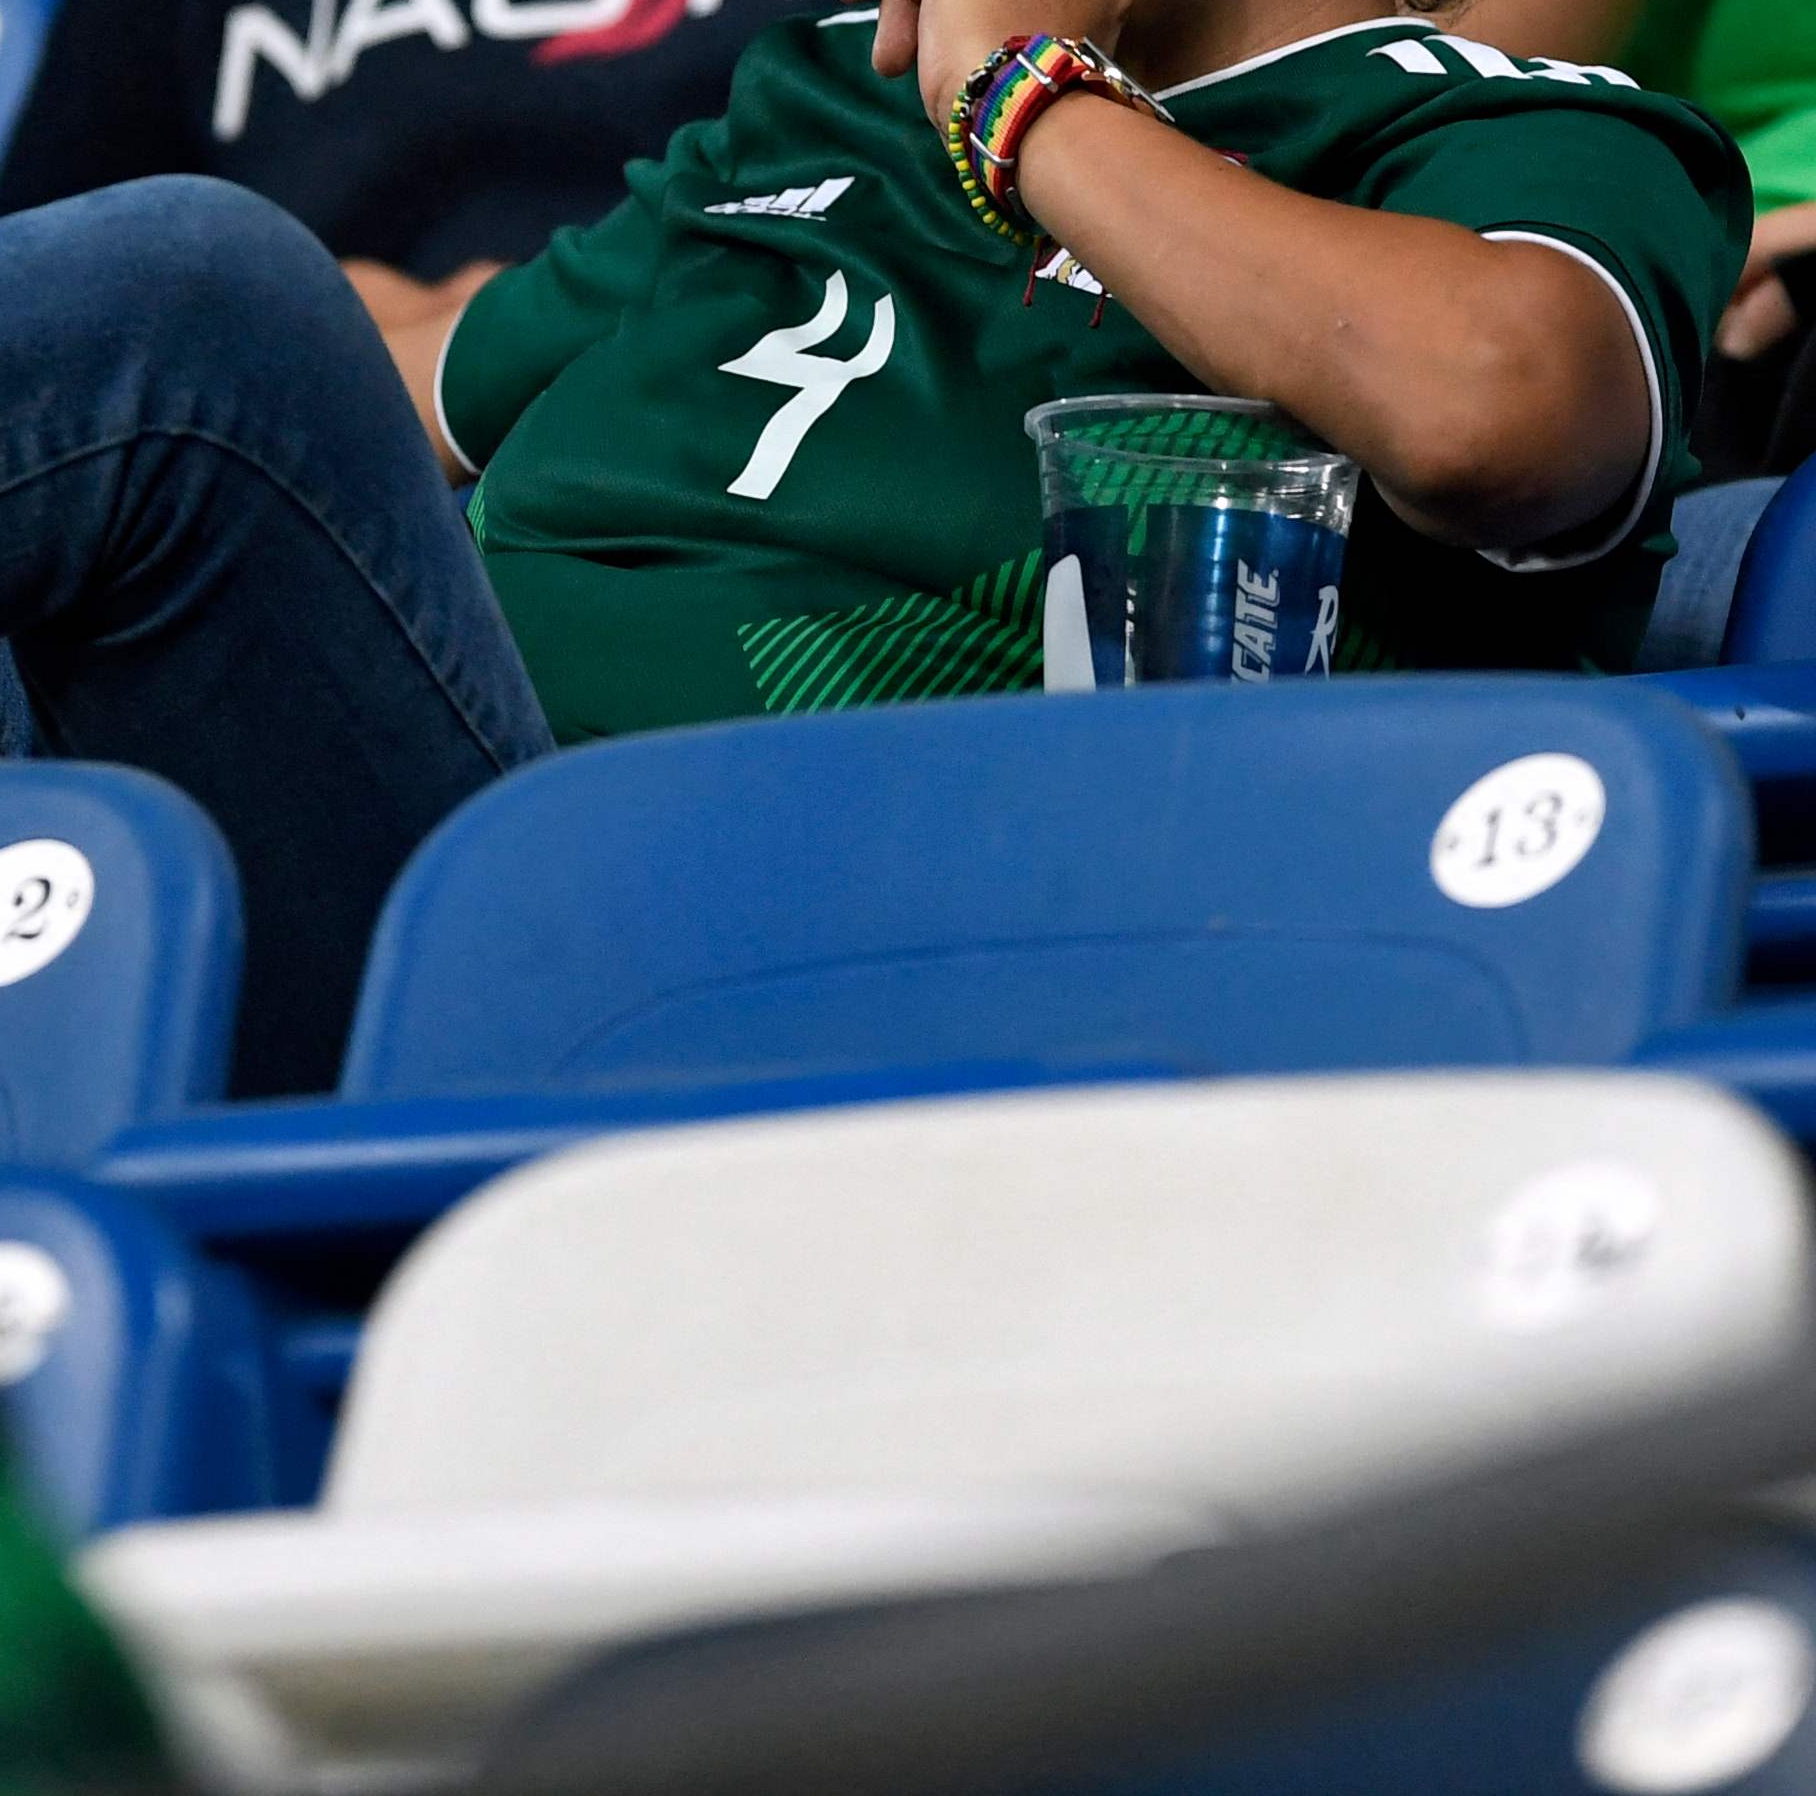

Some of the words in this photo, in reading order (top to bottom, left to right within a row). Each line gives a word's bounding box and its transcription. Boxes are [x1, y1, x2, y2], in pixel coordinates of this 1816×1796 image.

[719, 270, 894, 499] 4
[1231, 558, 1280, 683] CATE
[1303, 584, 1340, 681] R
[1476, 789, 1564, 869] 13
